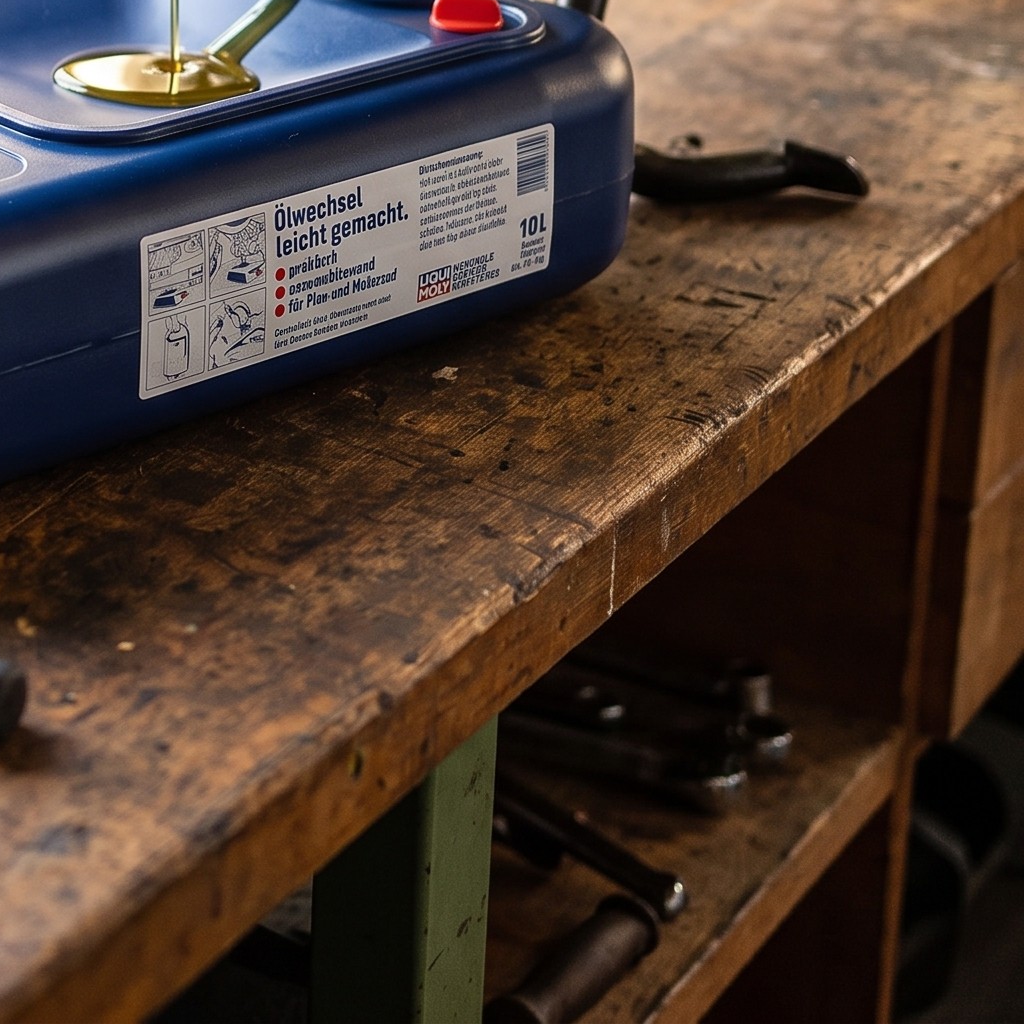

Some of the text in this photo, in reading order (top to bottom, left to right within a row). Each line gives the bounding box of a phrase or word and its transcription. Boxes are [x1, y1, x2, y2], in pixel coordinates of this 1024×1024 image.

[274, 186, 363, 232] Ölwechsel
[276, 223, 328, 258] leicht
[331, 201, 409, 247] gemacht.
[418, 281, 450, 301] MOLY
[419, 265, 451, 288] LIQUI
